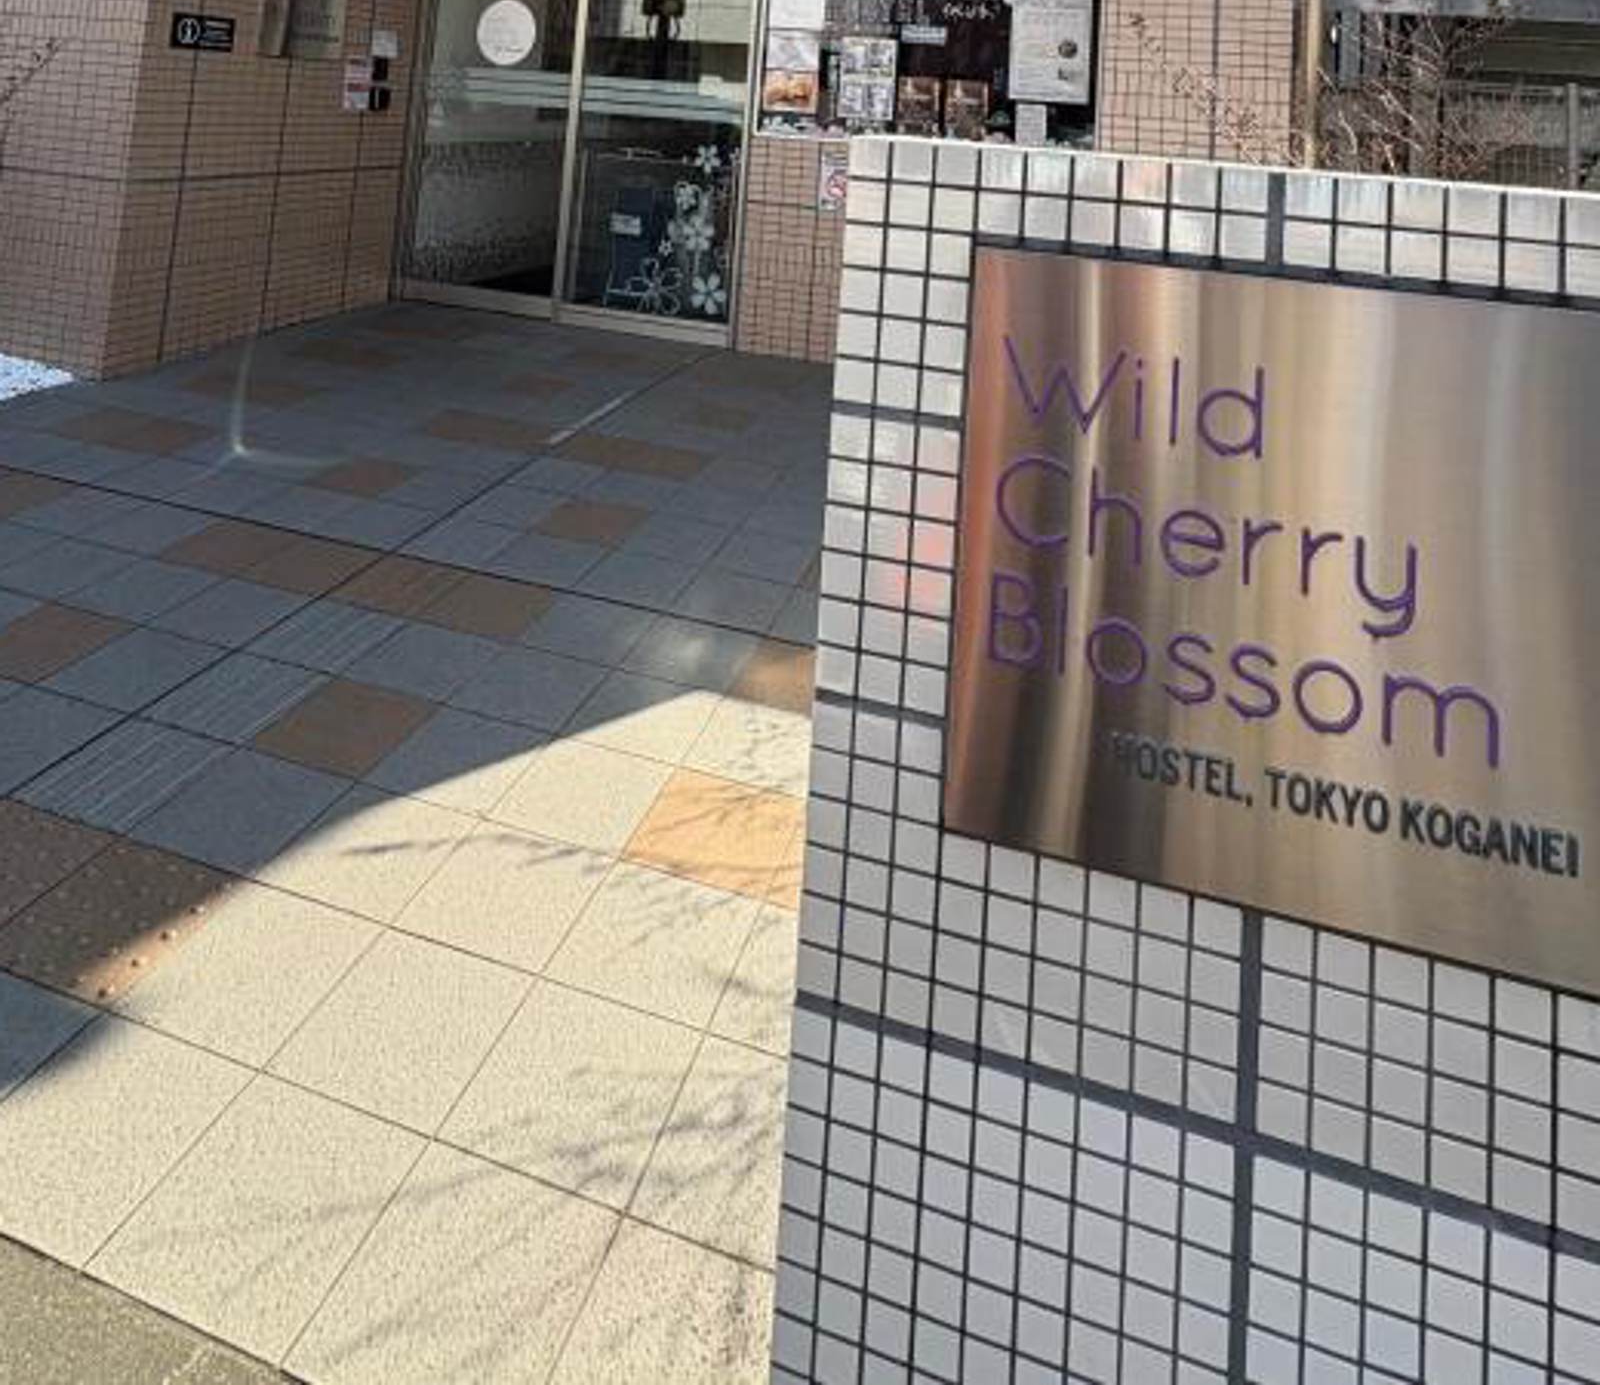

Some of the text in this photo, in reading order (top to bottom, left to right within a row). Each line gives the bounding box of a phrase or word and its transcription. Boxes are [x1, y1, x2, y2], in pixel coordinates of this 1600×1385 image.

[1004, 335, 1265, 459] Wild
[996, 456, 1418, 640] Cherry
[987, 572, 1501, 769] Blossom
[1265, 766, 1390, 834] TOKYO
[1401, 800, 1580, 877] KOGANEI
